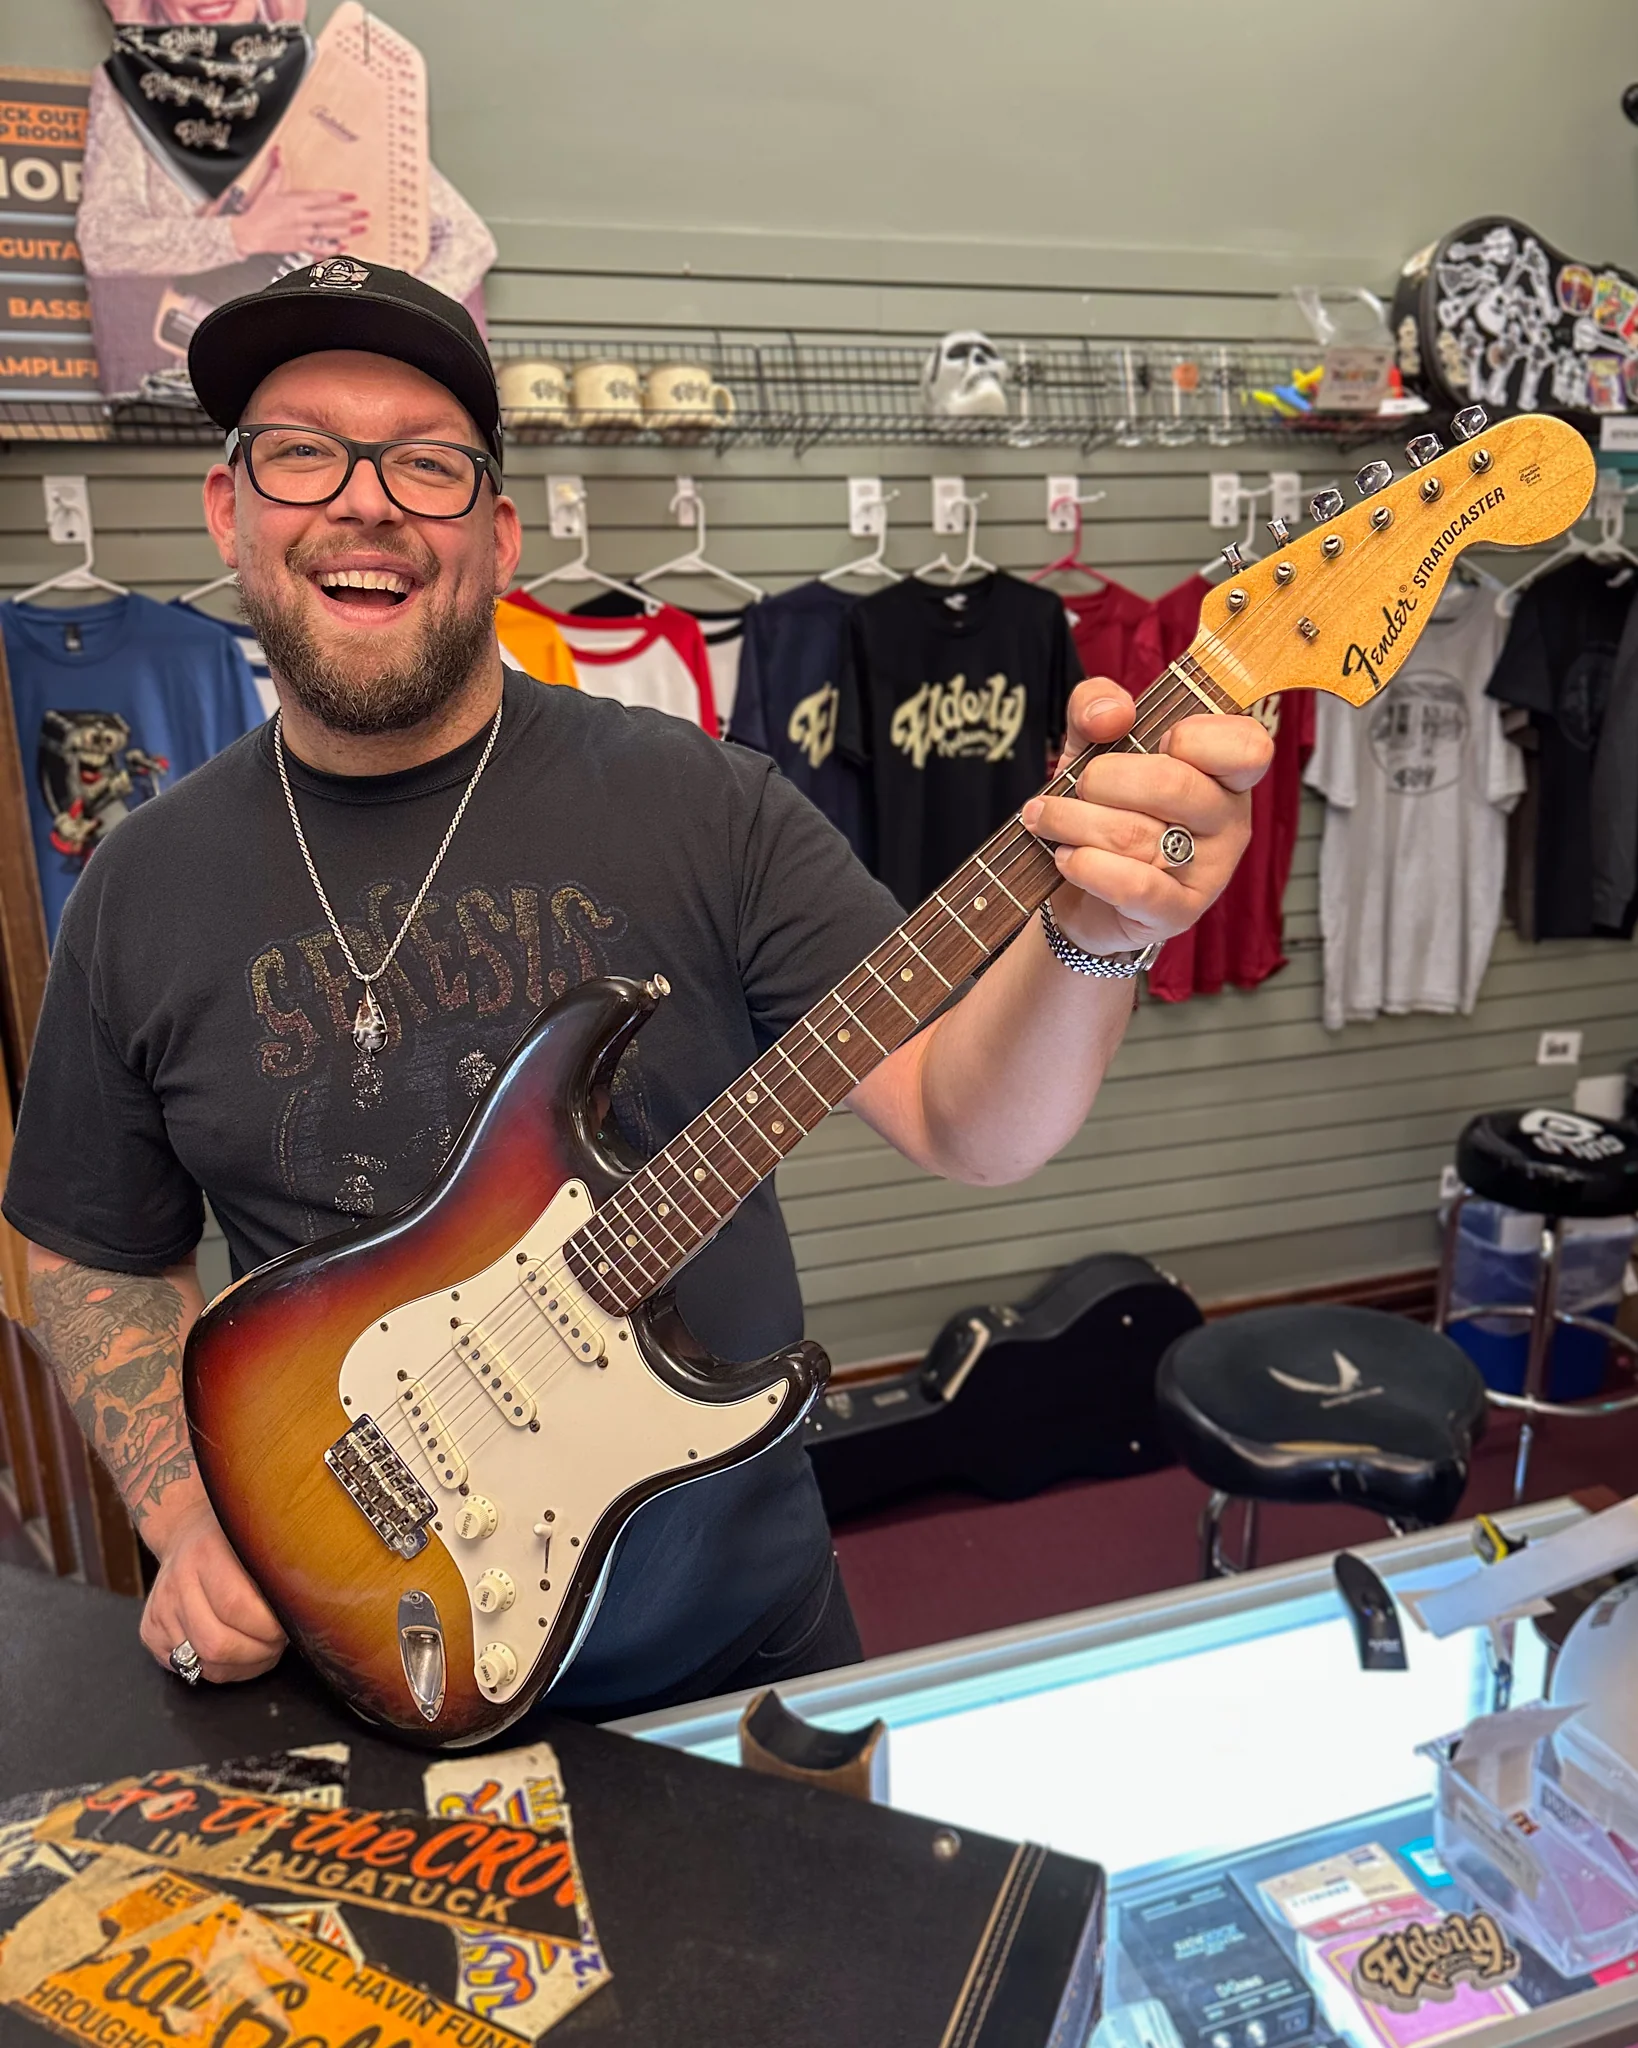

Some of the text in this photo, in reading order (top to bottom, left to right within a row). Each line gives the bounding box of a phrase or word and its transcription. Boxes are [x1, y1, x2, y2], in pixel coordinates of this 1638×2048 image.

[16, 125, 80, 142] ROOM
[38, 109, 80, 126] OUT
[1413, 486, 1506, 590] STRATOCASTER
[890, 672, 1027, 770] Elderly
[480, 1590, 490, 1608] TONE
[480, 1664, 492, 1682] TONE
[290, 1807, 418, 1867] the
[1361, 1914, 1503, 1997] Elderly
